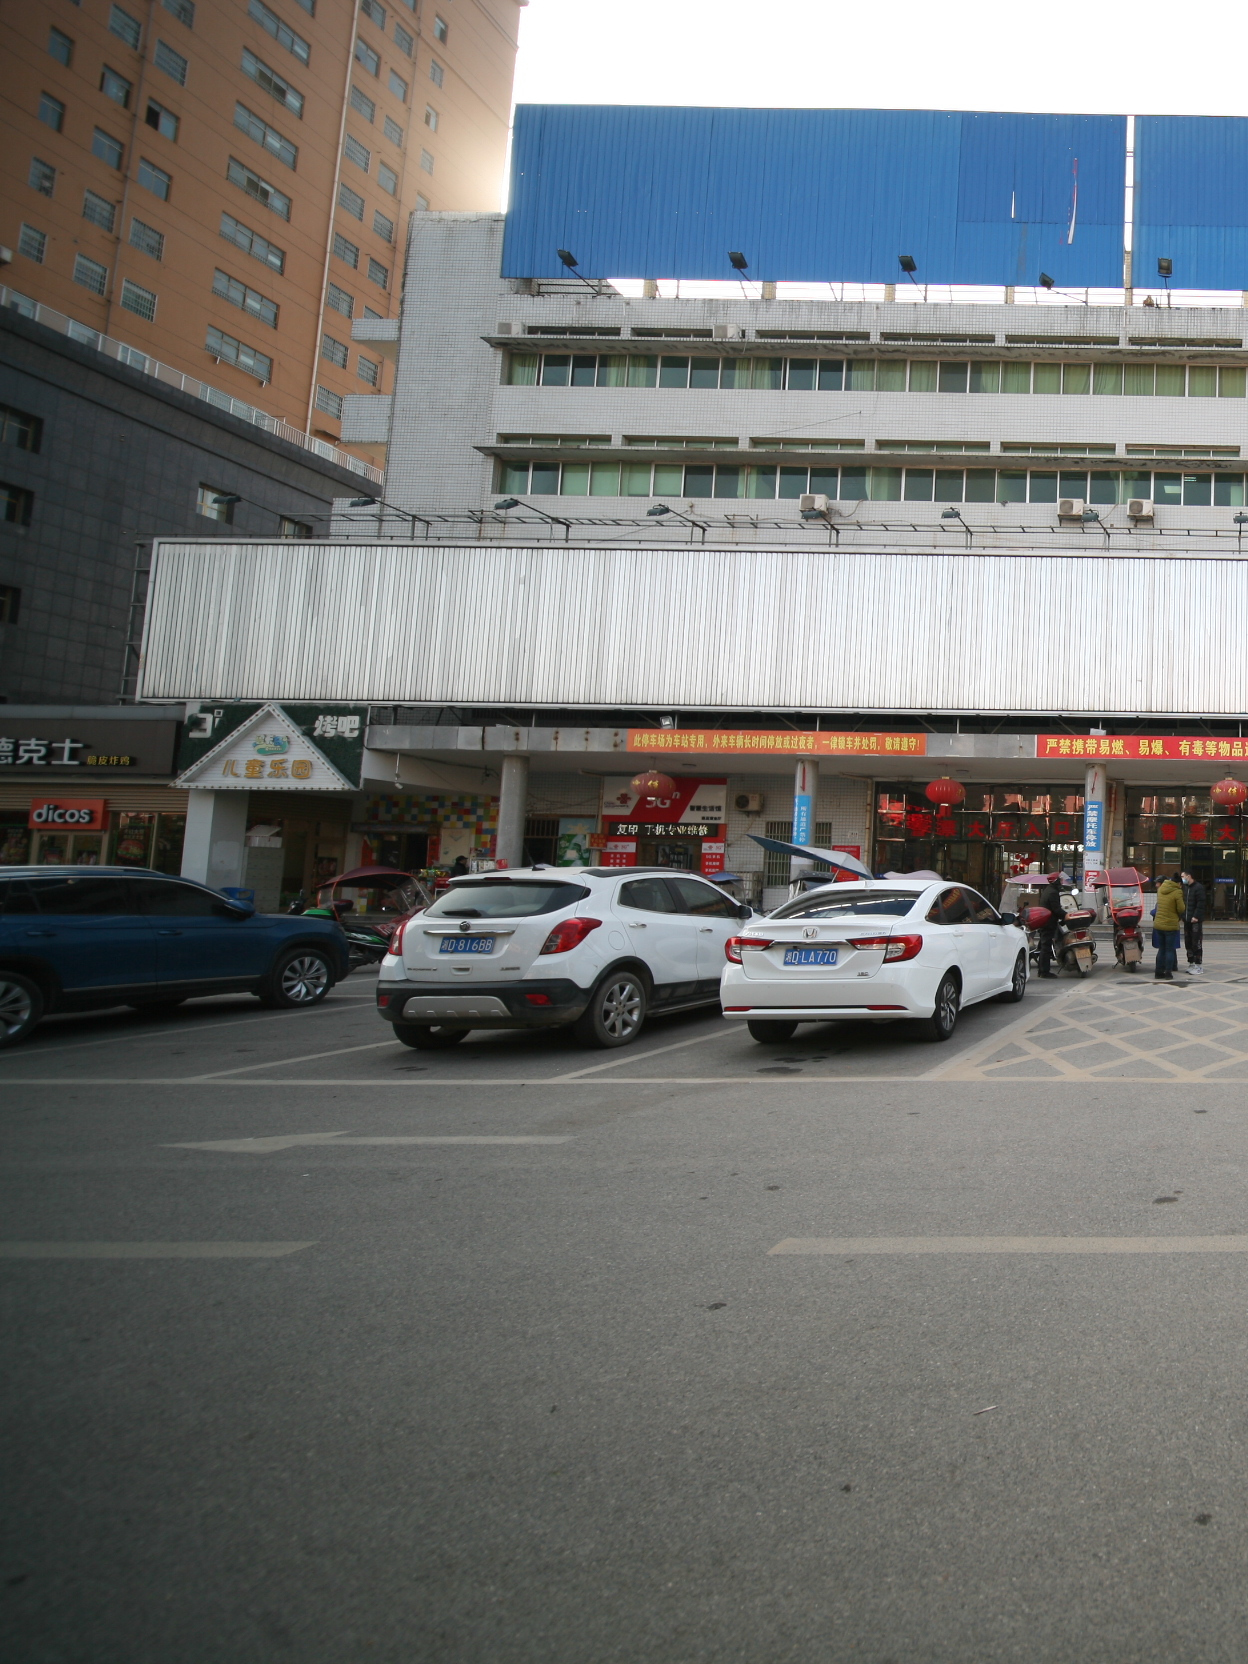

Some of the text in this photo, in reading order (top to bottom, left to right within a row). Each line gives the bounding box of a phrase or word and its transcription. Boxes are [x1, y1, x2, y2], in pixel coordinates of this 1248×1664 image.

[313, 714, 360, 738] 烤吧
[222, 758, 312, 779] 儿童乐园
[32, 804, 91, 823] dicos
[616, 823, 639, 836] 复印
